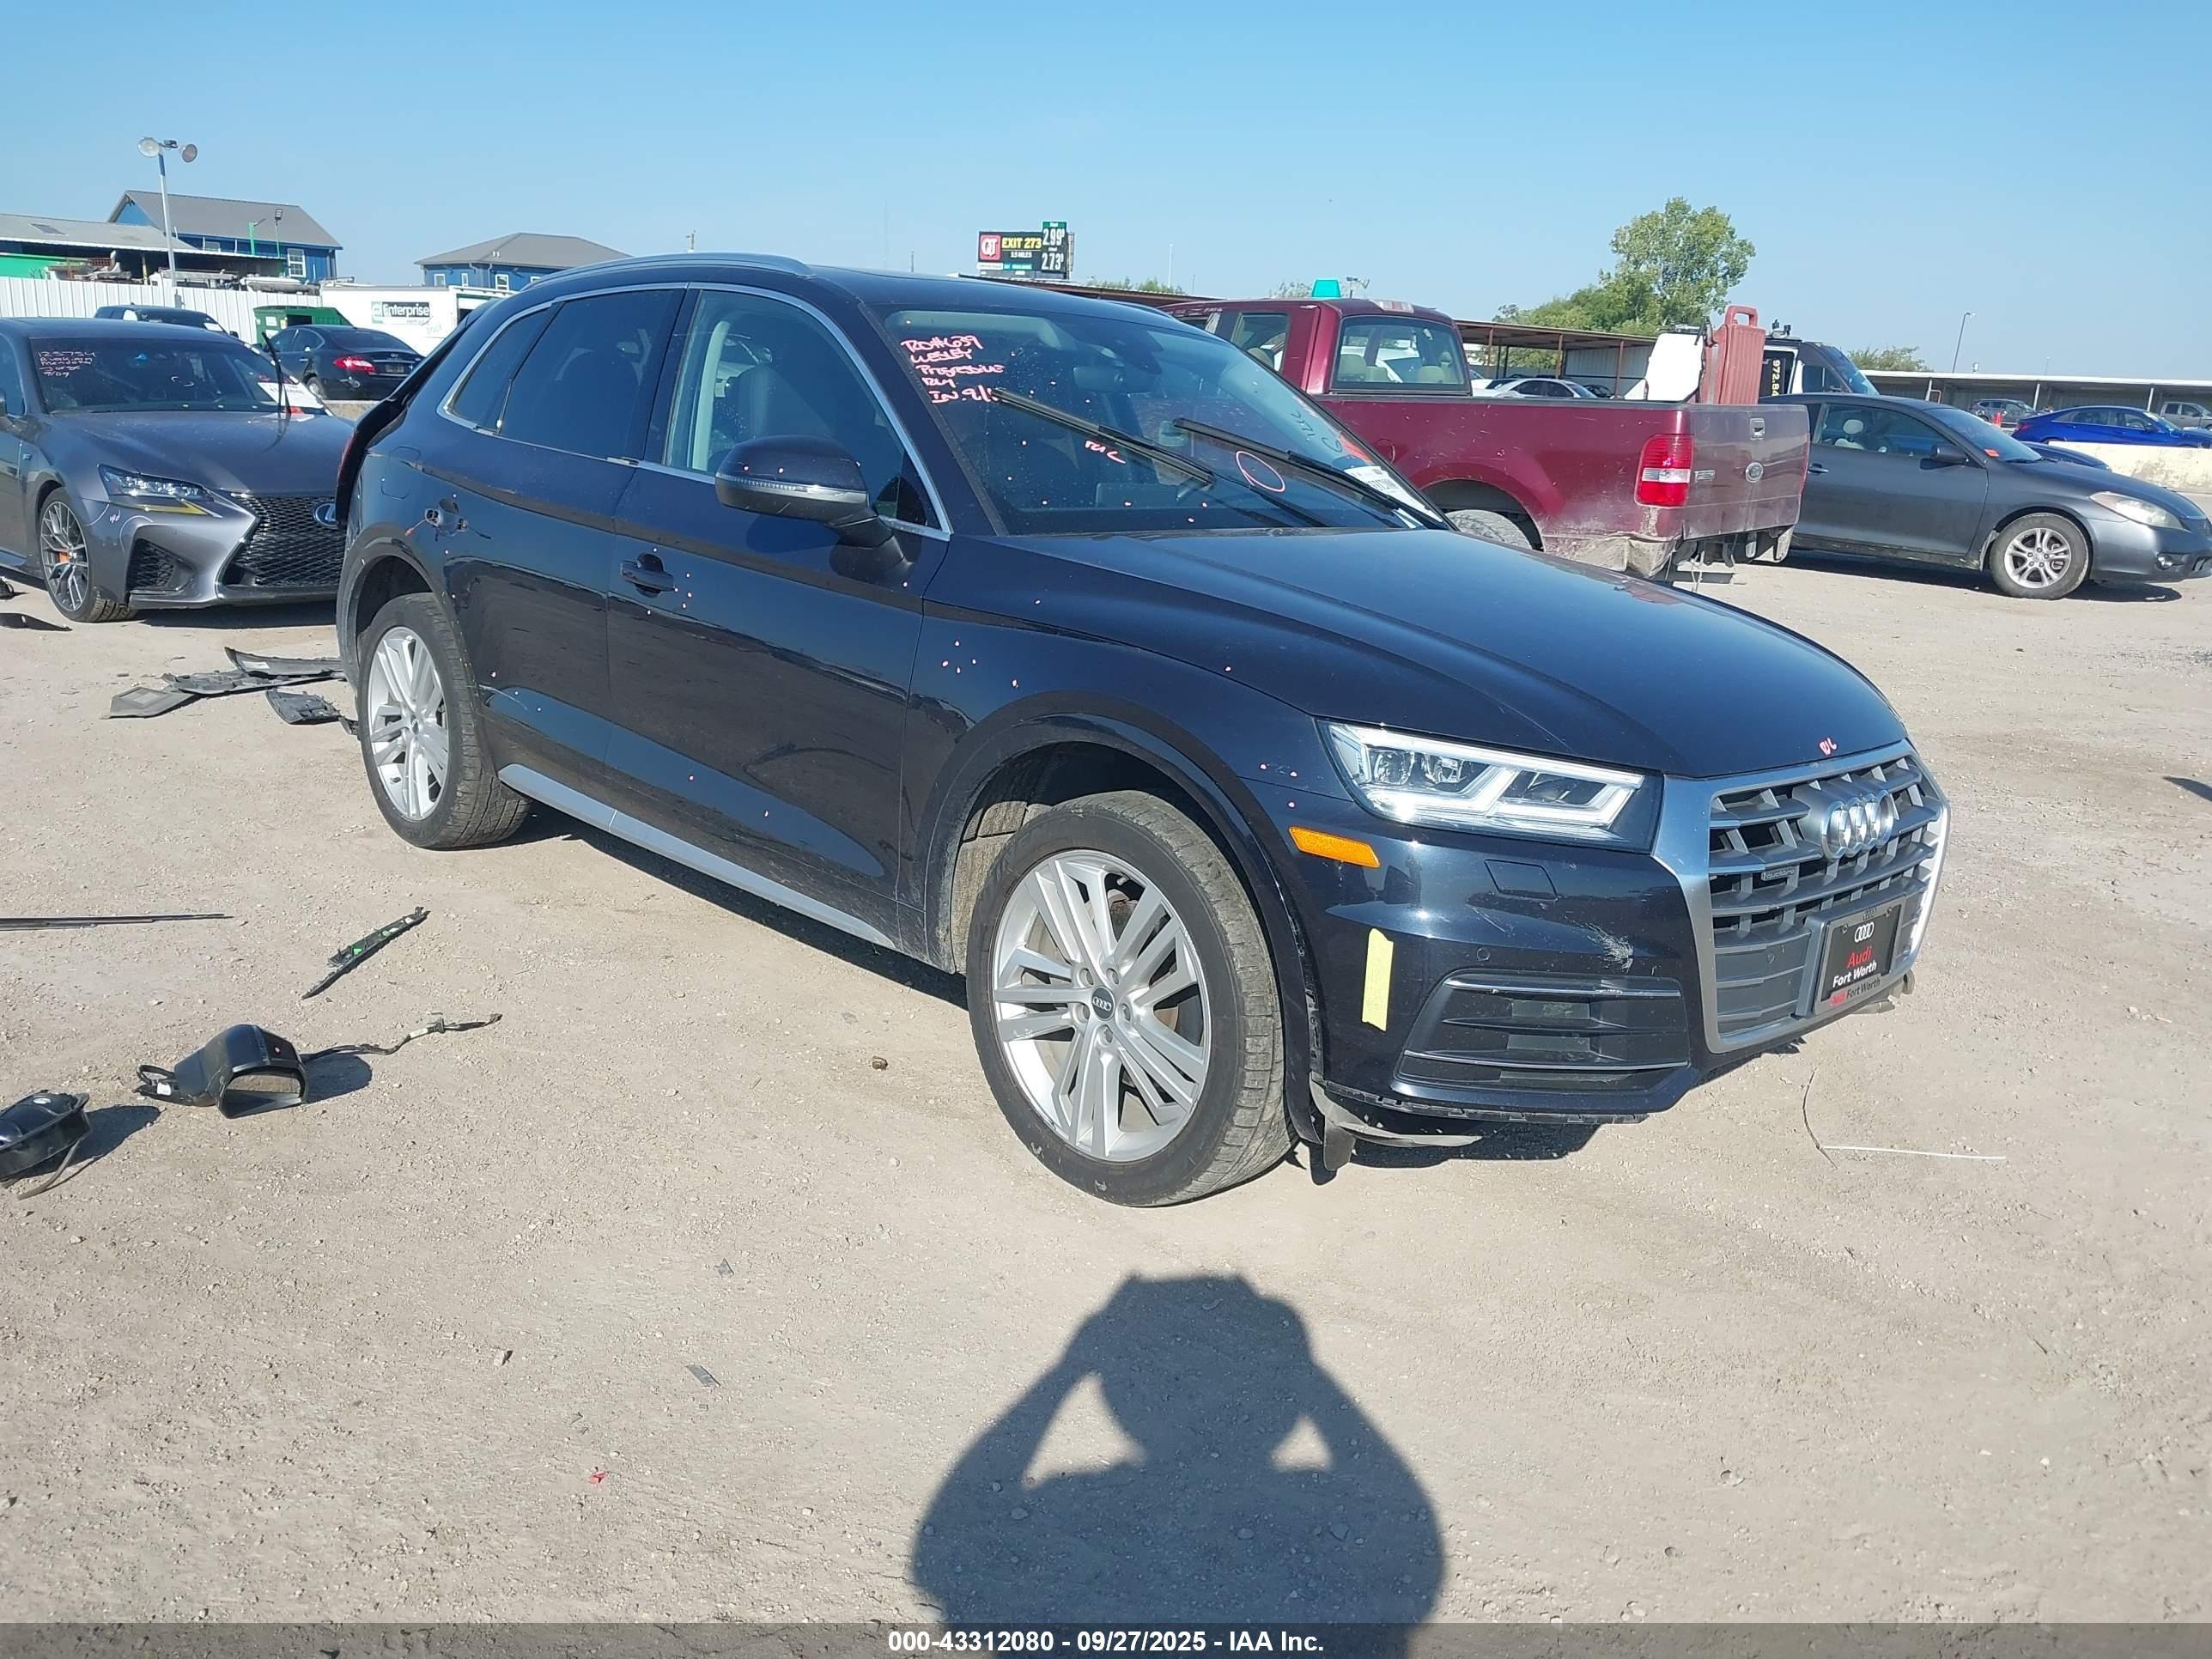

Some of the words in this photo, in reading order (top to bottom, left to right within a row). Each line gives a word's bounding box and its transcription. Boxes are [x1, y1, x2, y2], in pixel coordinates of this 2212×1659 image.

[1001, 237, 1023, 249] EXIT
[1024, 237, 1042, 249] 273
[383, 303, 429, 318] Enterprise
[910, 349, 972, 363] WESLEY
[1847, 945, 1873, 969] Audi
[1832, 974, 1851, 988] Fort
[1853, 959, 1877, 980] Worth
[1847, 986, 1860, 1000] Fort
[1861, 977, 1881, 993] Worth
